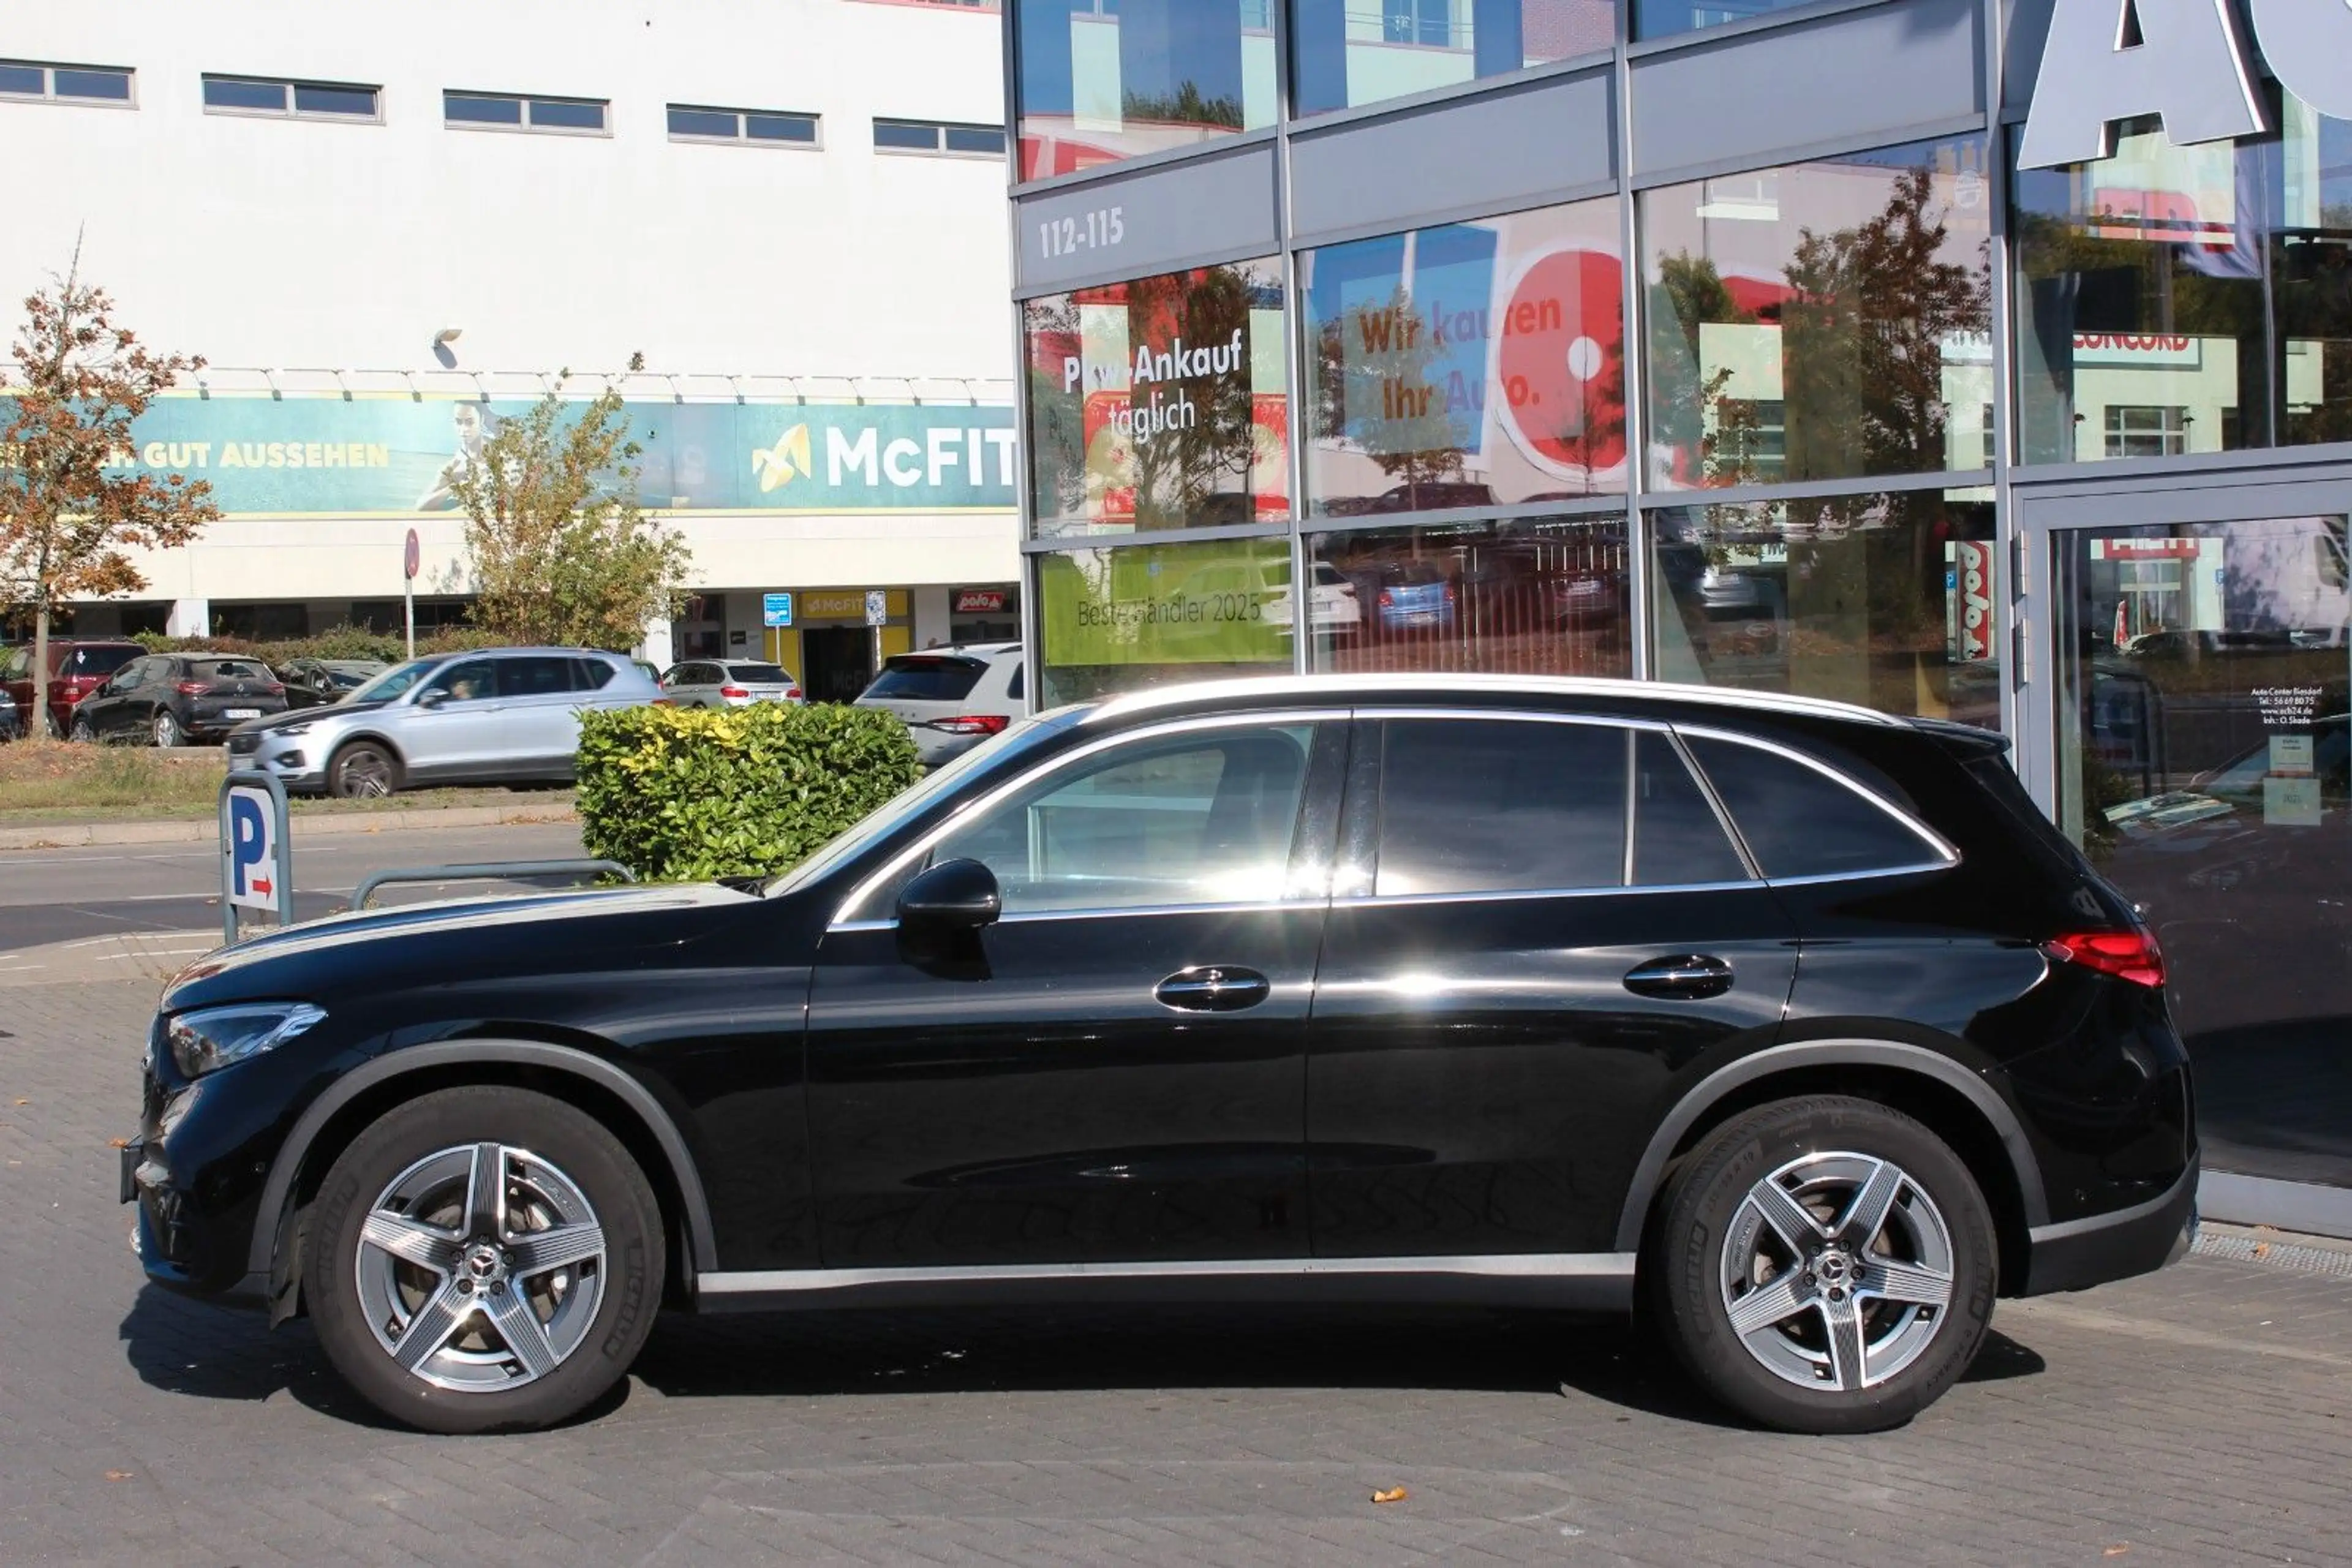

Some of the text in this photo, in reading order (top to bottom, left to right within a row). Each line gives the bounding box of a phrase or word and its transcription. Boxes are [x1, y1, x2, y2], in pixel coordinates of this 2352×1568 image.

[1040, 206, 1124, 259] 112-115
[1359, 306, 1421, 354] Wir
[1108, 387, 1195, 445] täglich
[1383, 370, 1540, 420] Ihr Auo.
[143, 442, 211, 469] GUT
[219, 442, 389, 469] AUSSEHEN
[826, 426, 1017, 487] McFIT
[823, 598, 865, 612] McFIT
[959, 593, 989, 611] polo
[1213, 593, 1261, 622] 2025
[231, 794, 265, 895] P
